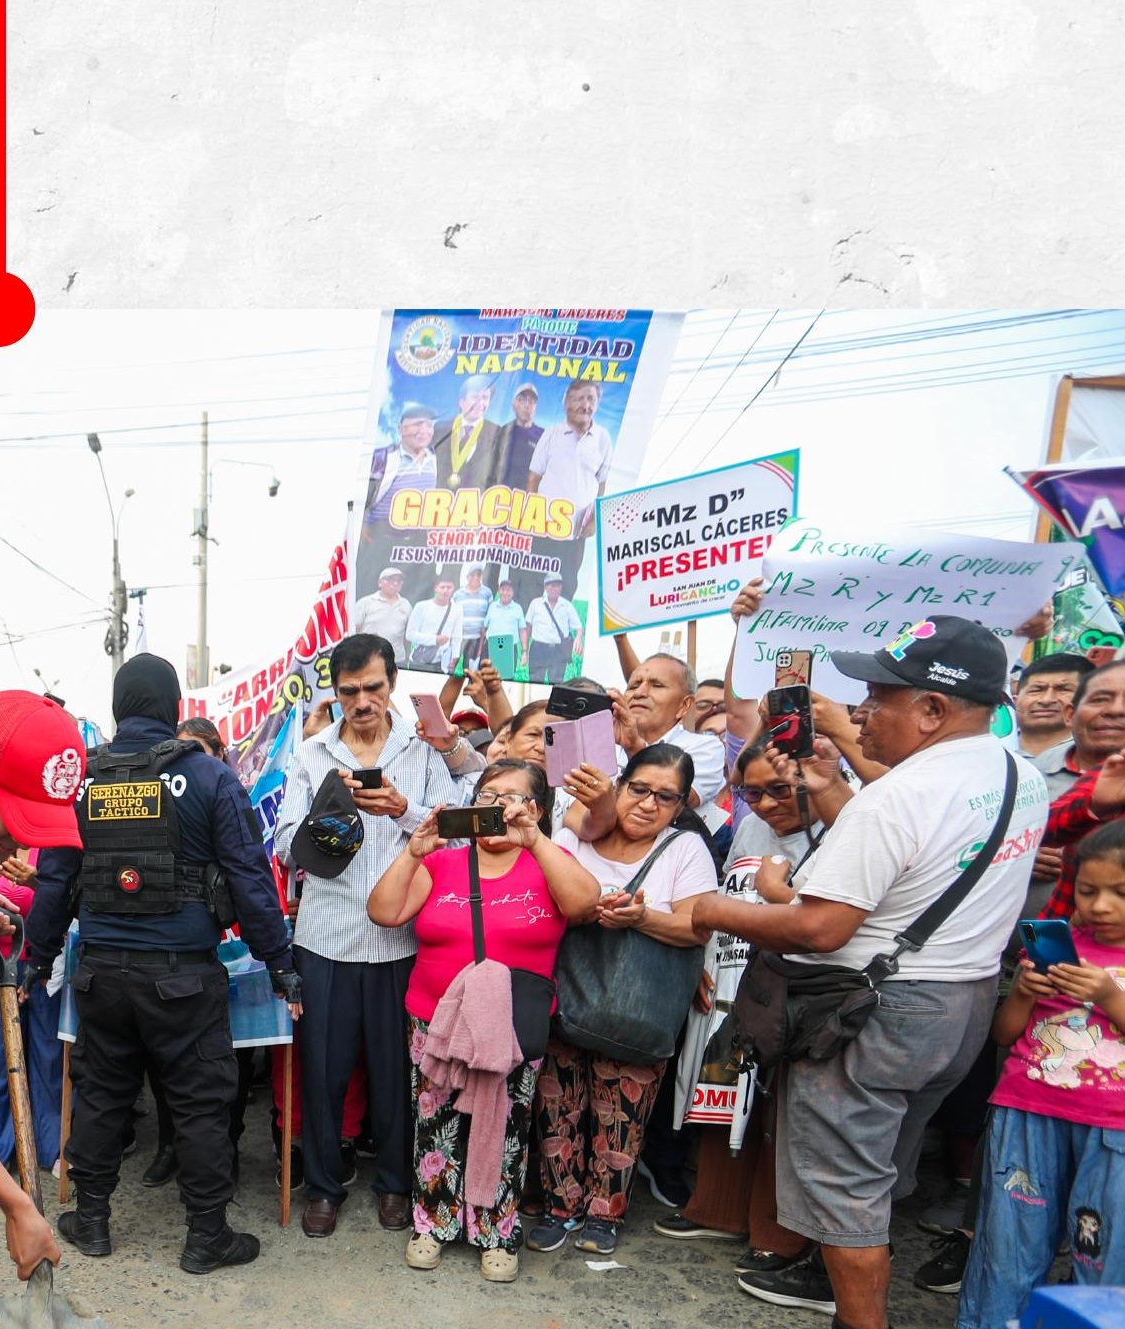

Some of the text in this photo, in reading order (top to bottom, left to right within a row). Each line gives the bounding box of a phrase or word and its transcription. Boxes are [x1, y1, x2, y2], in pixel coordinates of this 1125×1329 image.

[458, 333, 635, 360] IDENTIDAD
[455, 352, 627, 382] NACIONAL
[390, 486, 575, 539] GRACIAS
[477, 530, 532, 551] ALCALDE
[607, 507, 788, 562] MARISCAL CÁCERES
[391, 547, 561, 573] JESUS MALDONADO AMAO
[899, 549, 933, 567] LA
[673, 583, 687, 592] SAN
[688, 580, 705, 590] JUAN
[926, 673, 957, 686] Alcalde
[928, 661, 971, 681] Jesús
[91, 785, 158, 800] SERENAZGO
[98, 807, 149, 817] TACTICO
[104, 798, 143, 808] GRUPO
[968, 796, 983, 811] ES
